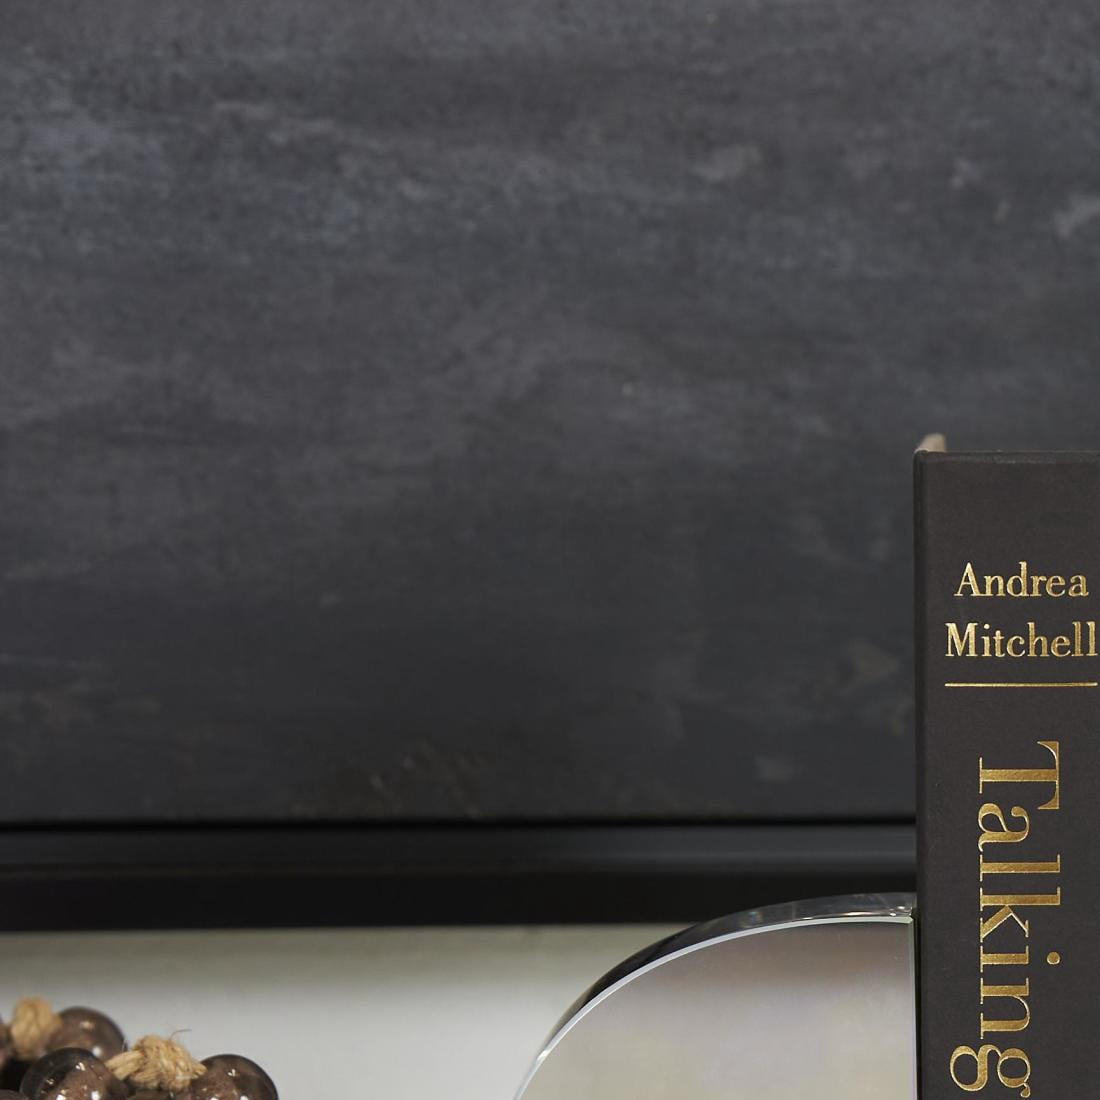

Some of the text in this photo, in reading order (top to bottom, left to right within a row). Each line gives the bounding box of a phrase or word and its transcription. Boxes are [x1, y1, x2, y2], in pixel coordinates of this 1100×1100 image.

[953, 561, 1090, 598] Andrea
[945, 621, 1099, 658] Mitchell
[949, 740, 1062, 1099] Talking
